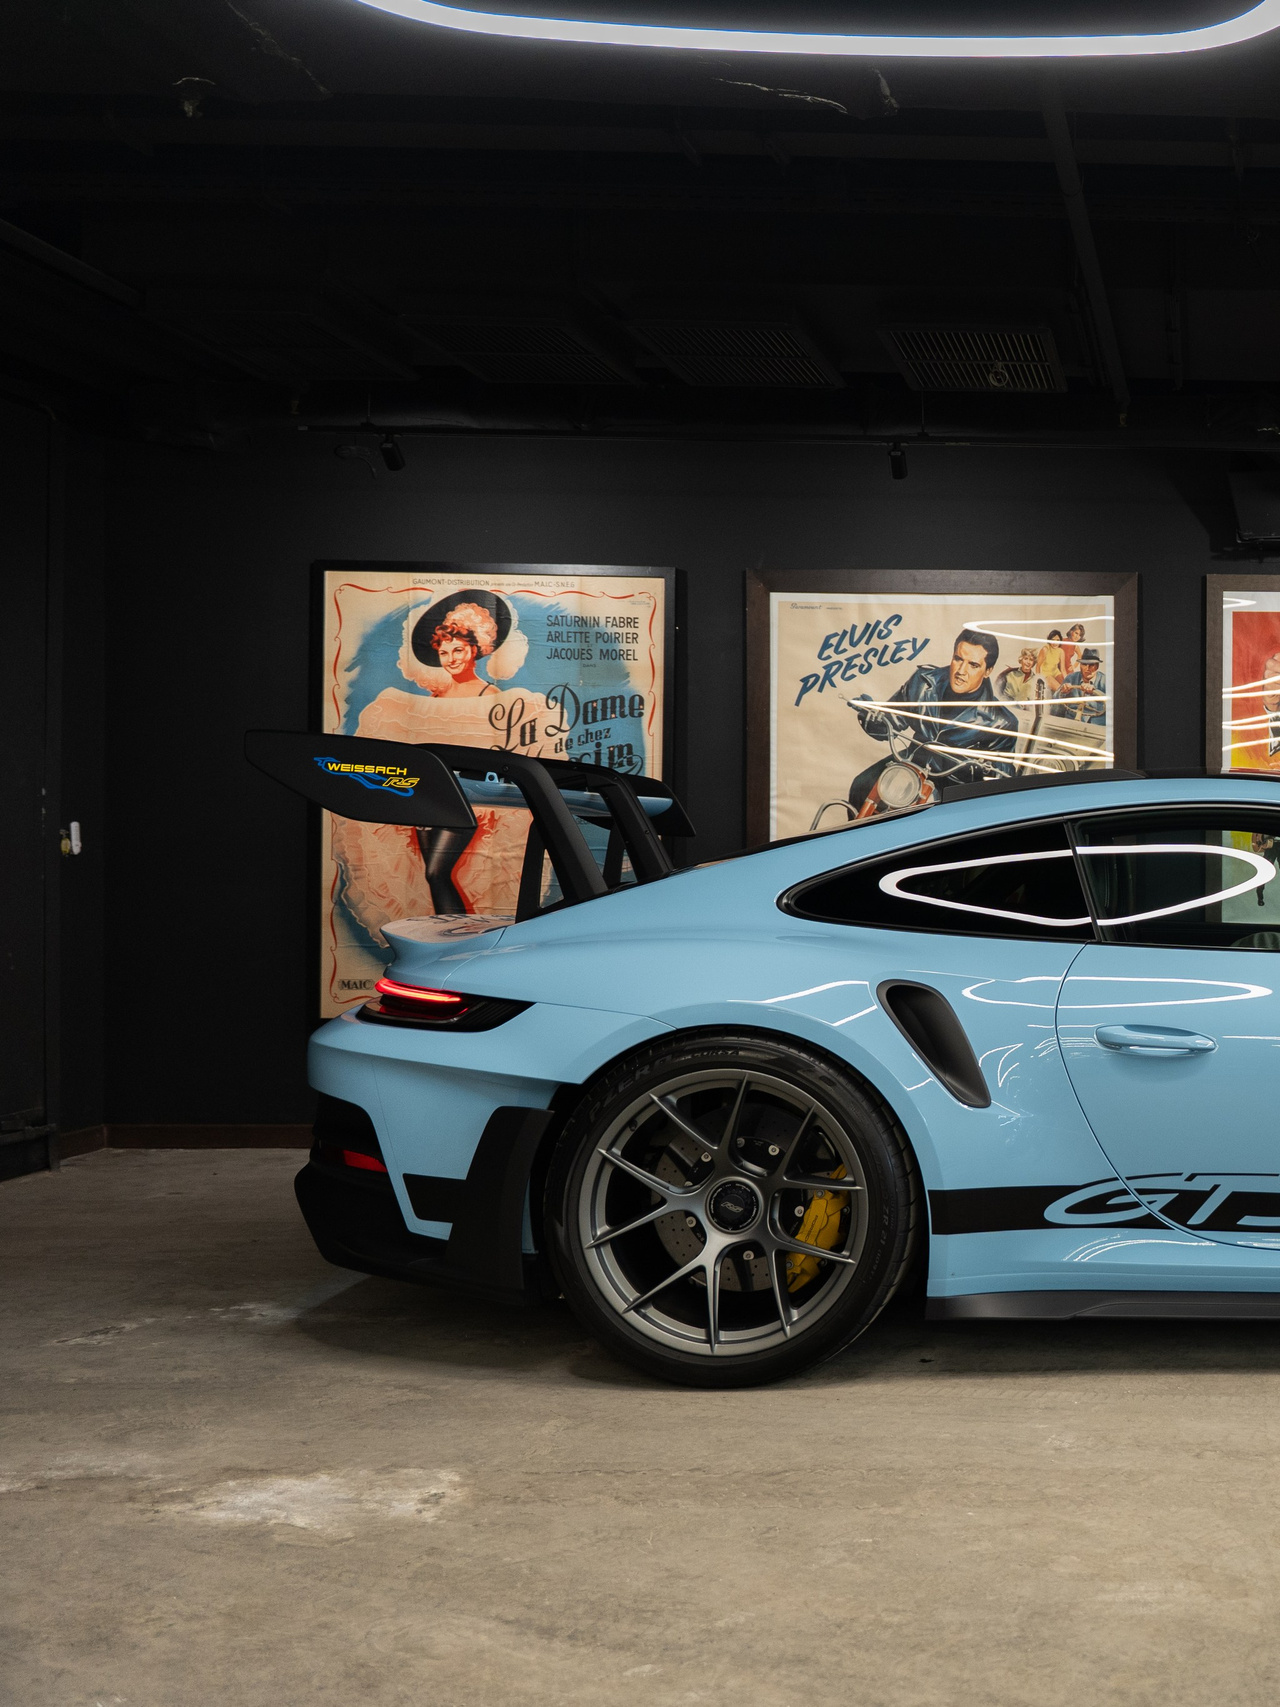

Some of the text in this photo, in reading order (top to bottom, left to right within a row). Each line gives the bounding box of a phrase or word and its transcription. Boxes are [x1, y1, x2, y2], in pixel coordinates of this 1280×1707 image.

[412, 579, 490, 587] GAUMONT-DISTRIBUTION
[546, 615, 639, 629] SATURNIN FABRE
[546, 631, 639, 644] ARLETTE POIRIER
[817, 614, 902, 661] ELVIS
[546, 648, 638, 661] JACQUES MOREL
[794, 637, 930, 707] PRESLEY
[488, 682, 645, 751] La Dame
[554, 728, 611, 754] de chez
[327, 762, 408, 775] WEISSACH
[382, 777, 420, 788] RS
